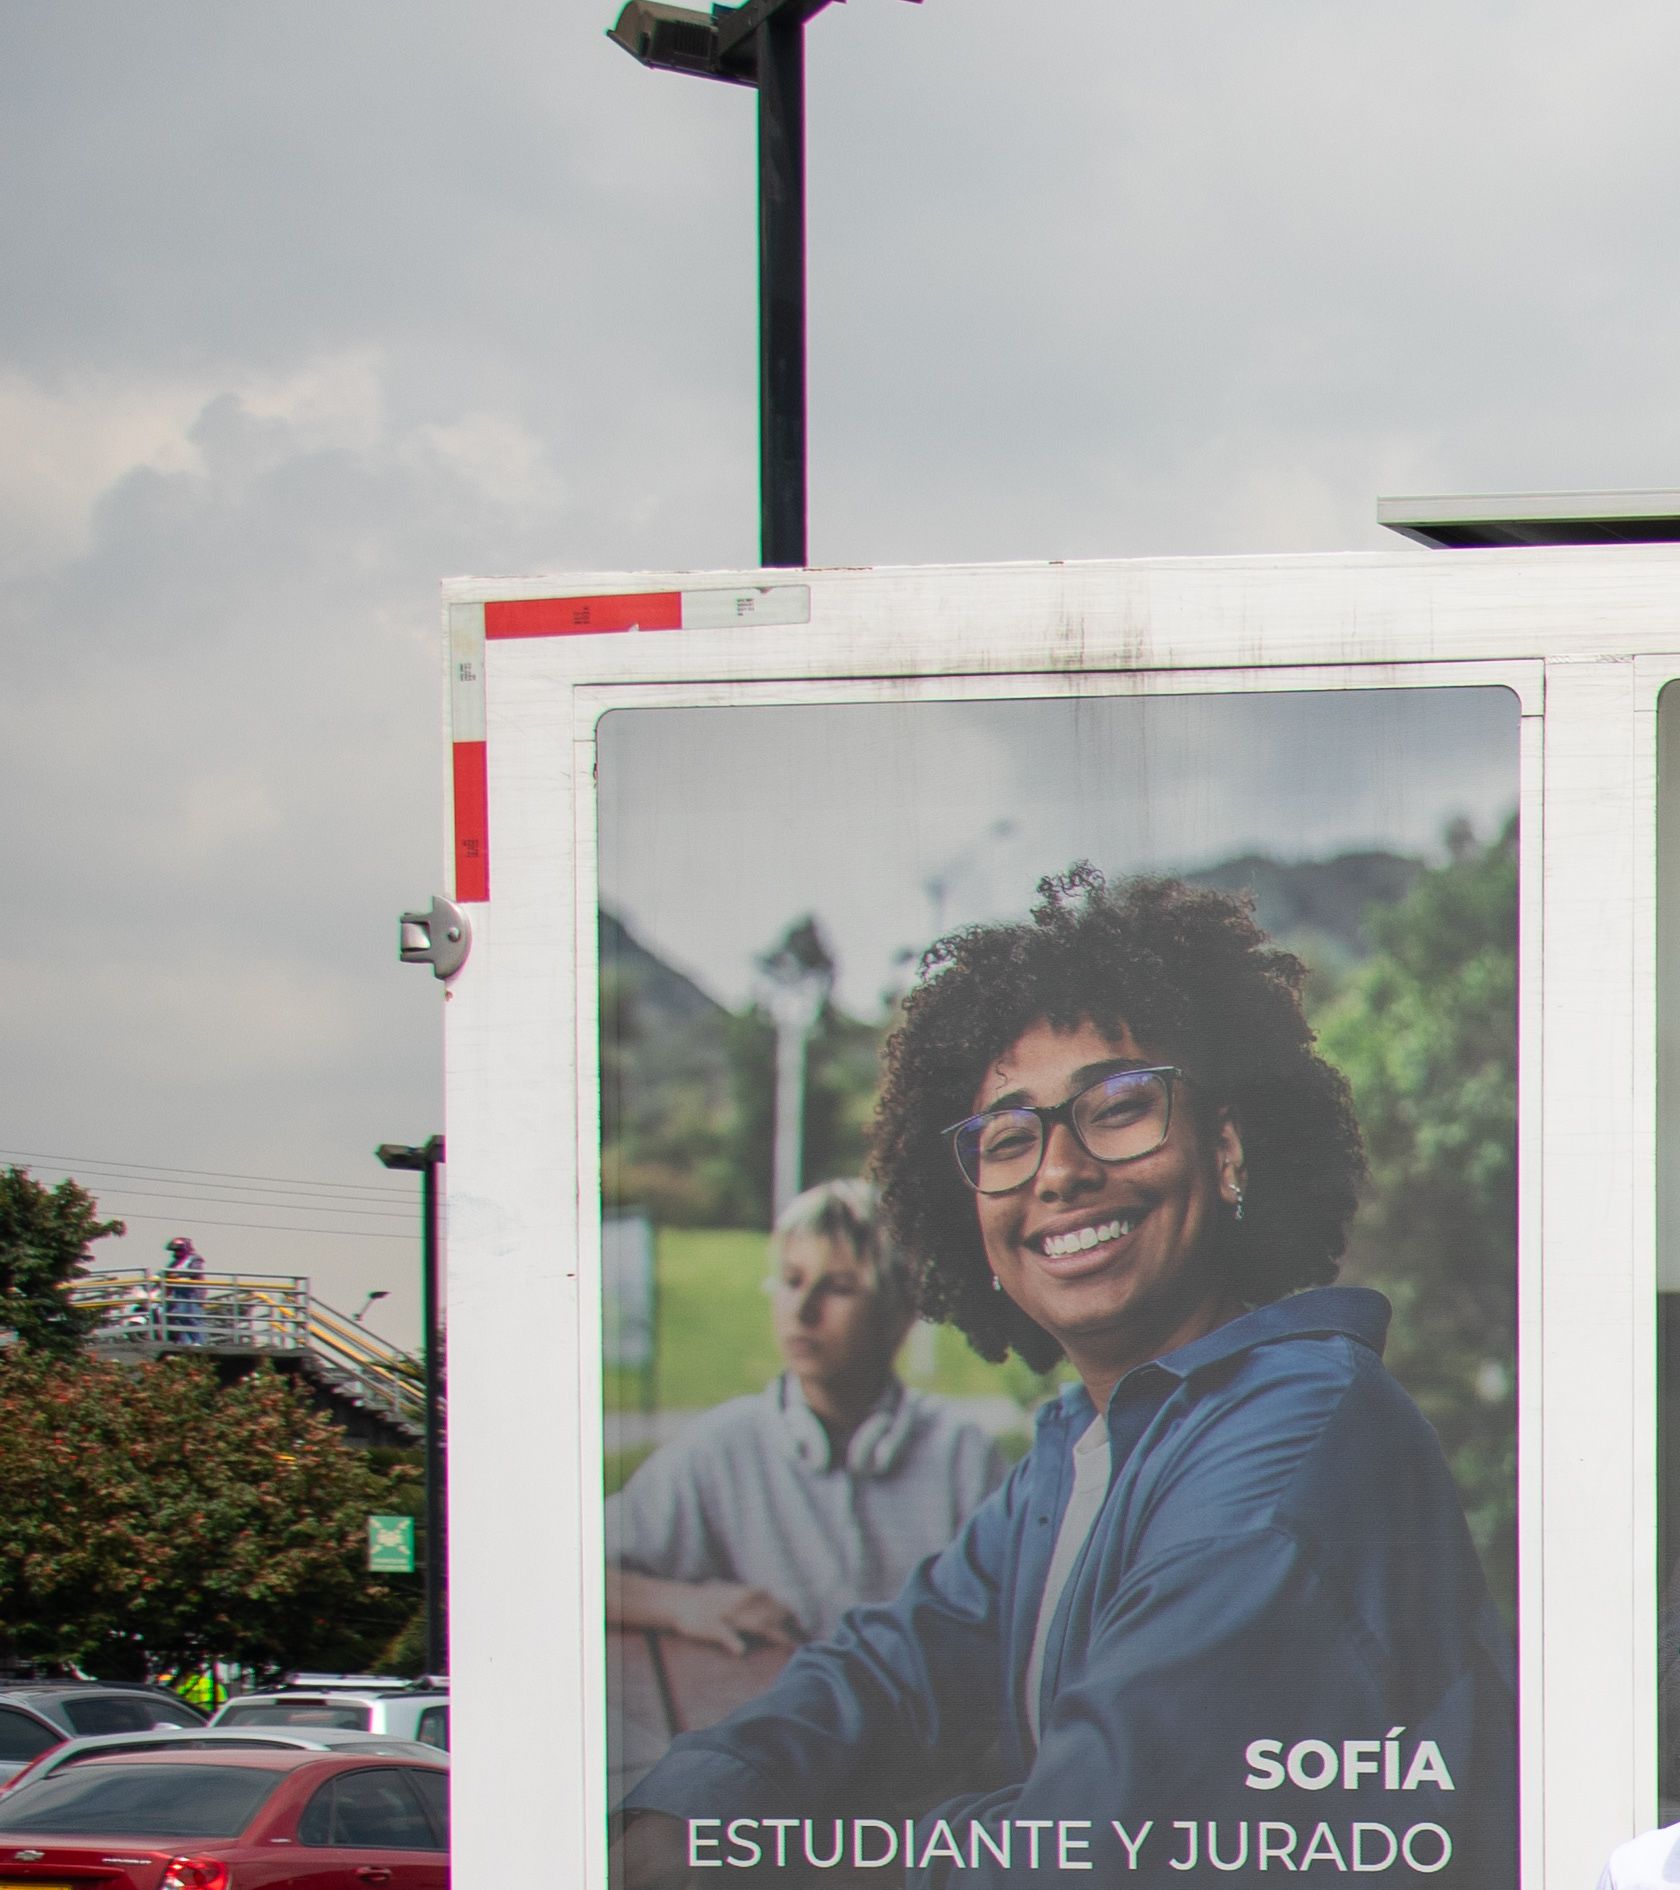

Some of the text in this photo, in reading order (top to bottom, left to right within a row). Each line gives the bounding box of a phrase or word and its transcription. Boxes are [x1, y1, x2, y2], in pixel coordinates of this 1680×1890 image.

[1245, 1727, 1455, 1791] SOFÍA
[687, 1818, 1453, 1873] ESTUDIANTE Y JURADO
